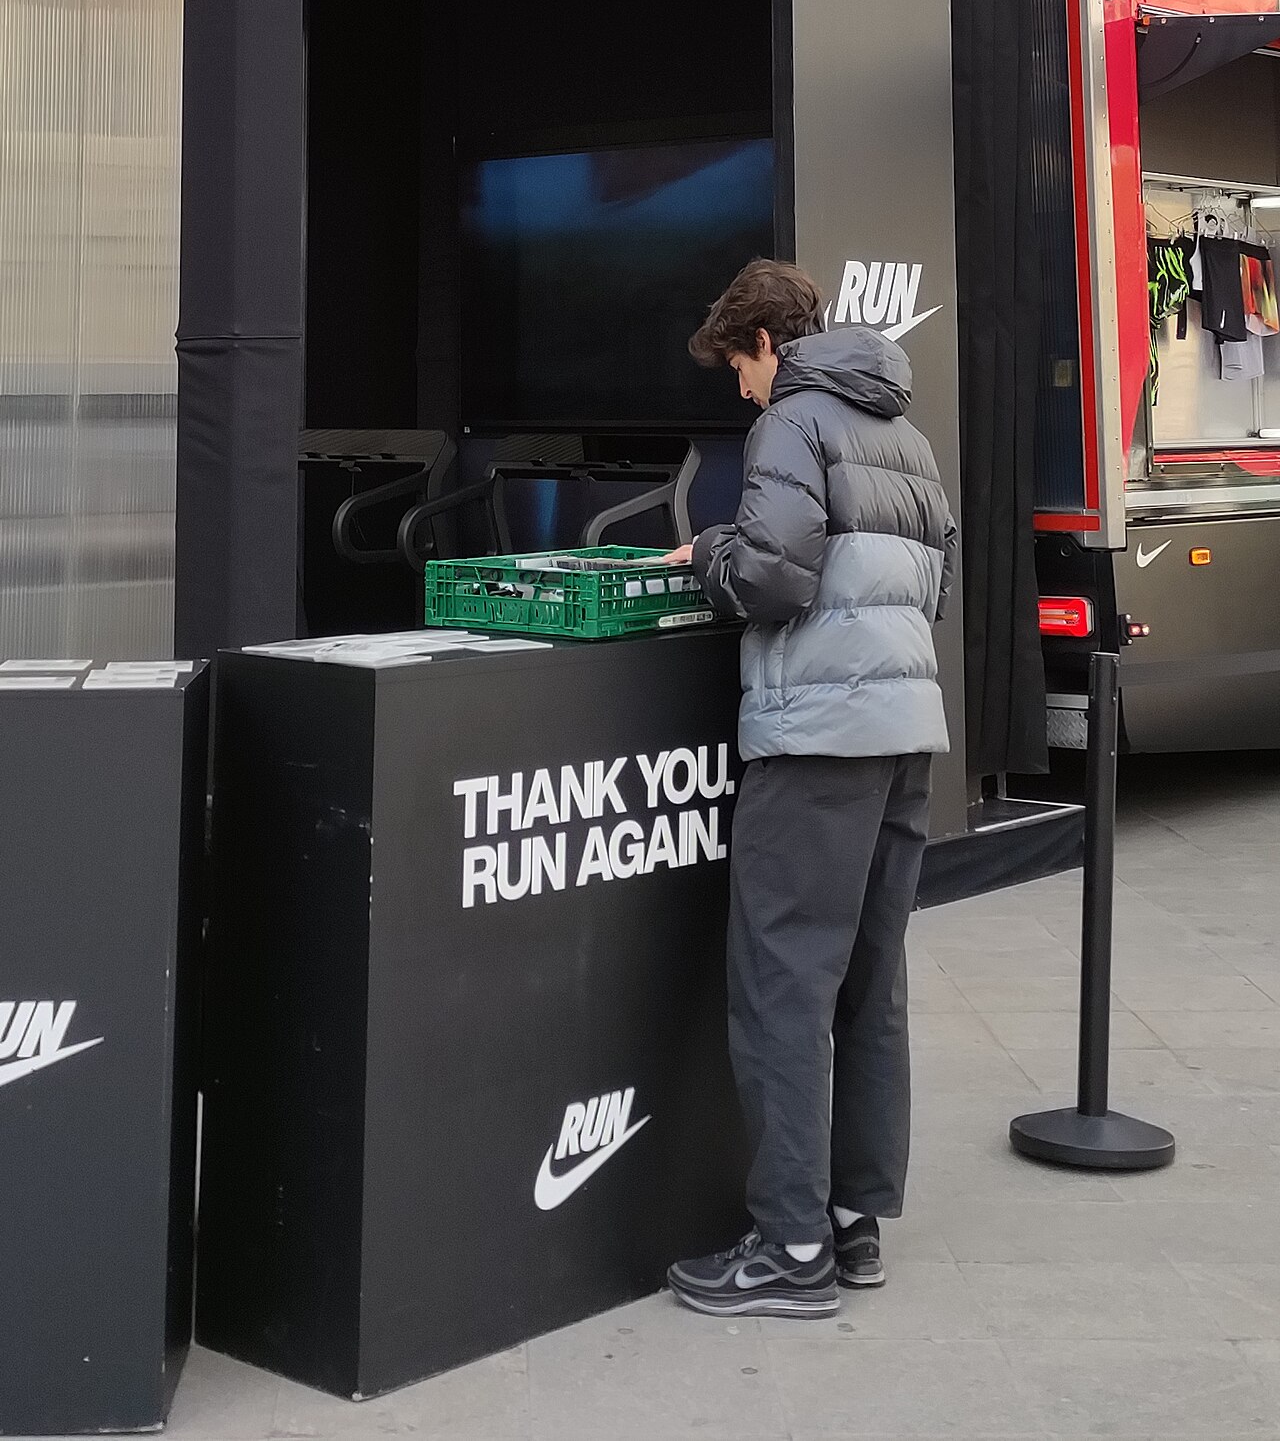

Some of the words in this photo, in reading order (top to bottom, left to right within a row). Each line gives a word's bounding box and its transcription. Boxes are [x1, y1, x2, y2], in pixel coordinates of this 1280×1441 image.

[834, 260, 923, 325] RUN
[453, 756, 628, 839] THANK
[636, 743, 735, 808] YOU.
[462, 832, 566, 908] RUN
[576, 807, 727, 887] AGAIN.
[554, 1087, 635, 1160] RUN
